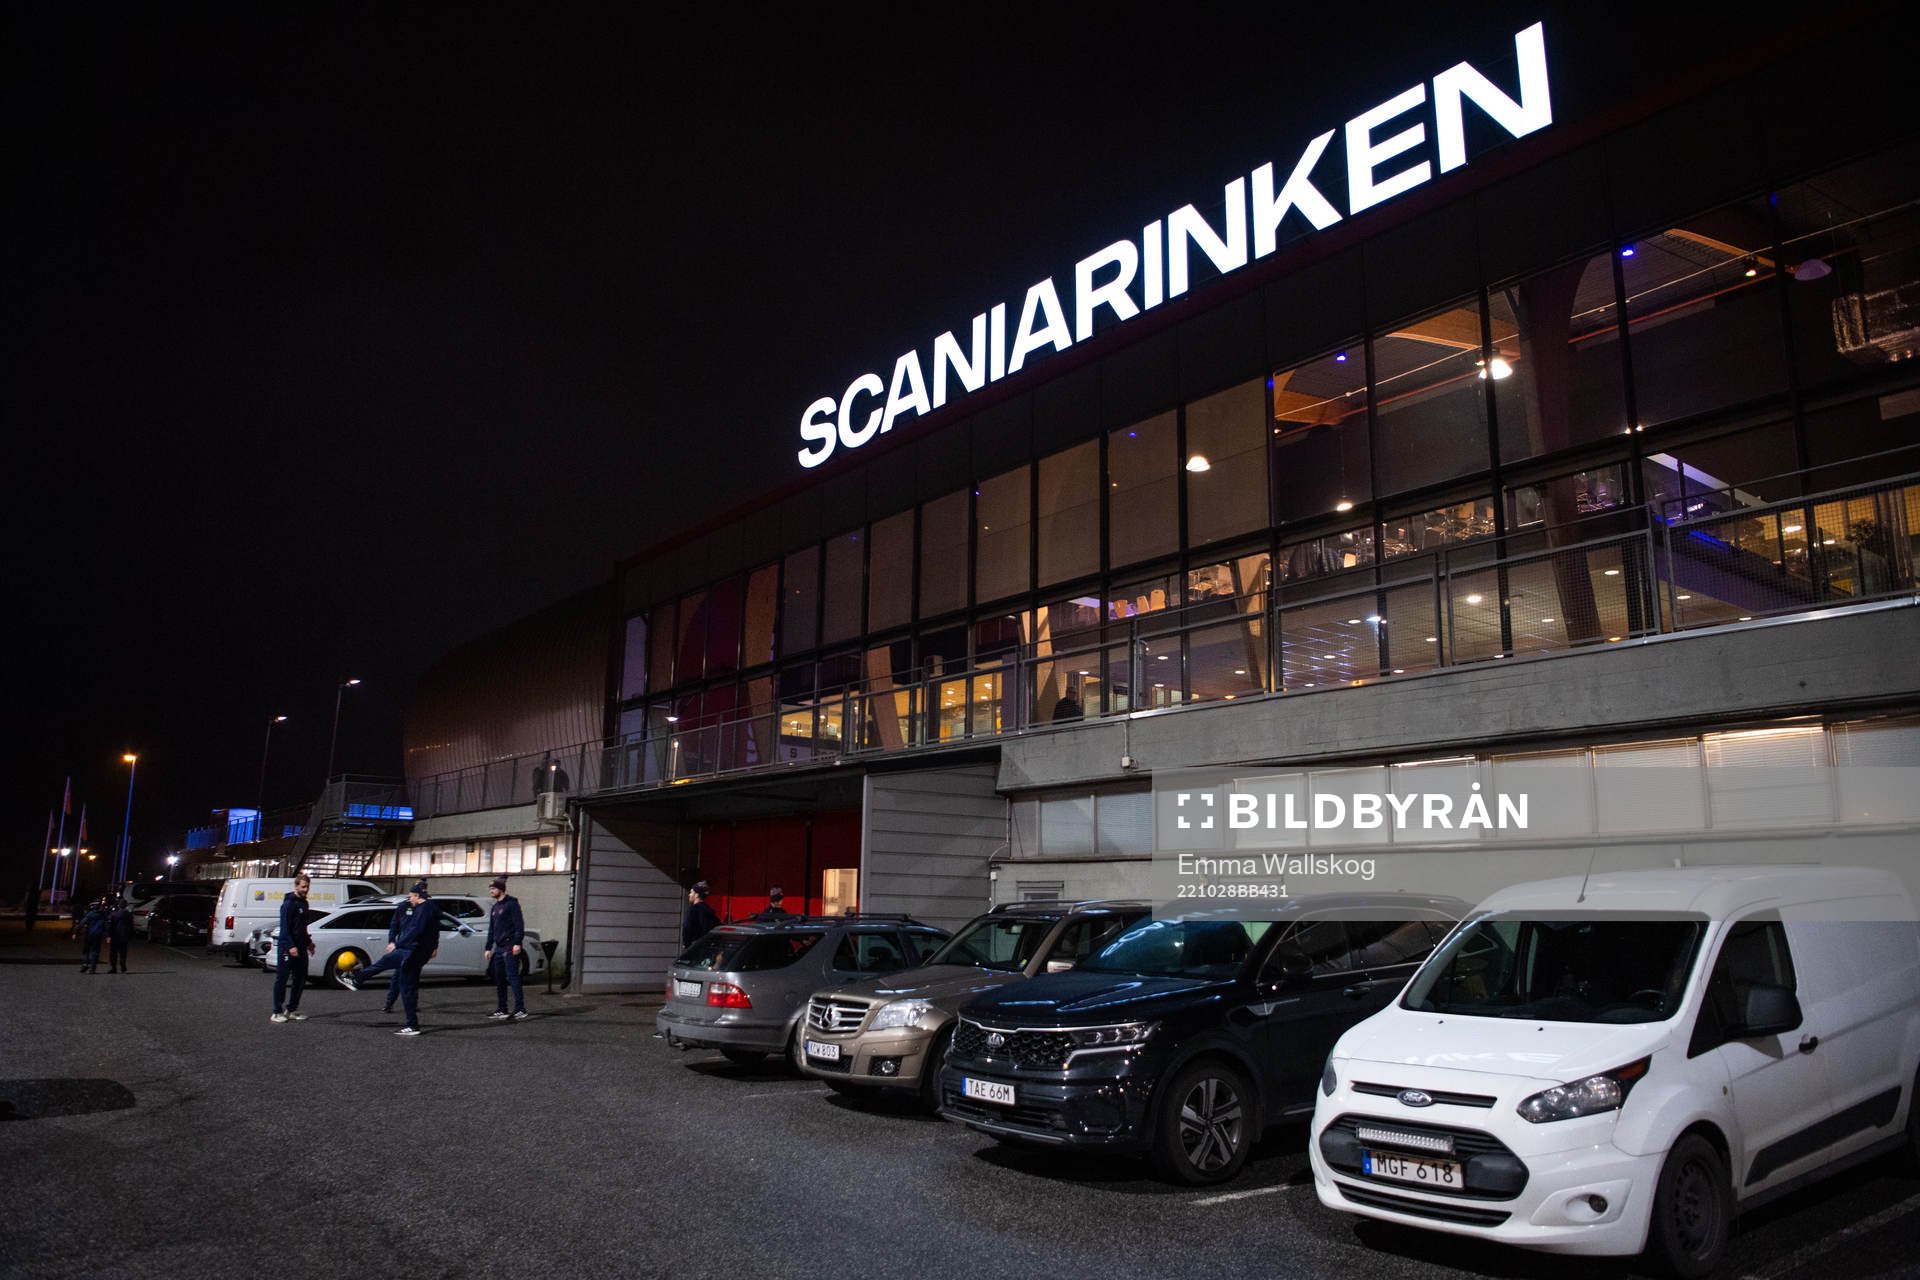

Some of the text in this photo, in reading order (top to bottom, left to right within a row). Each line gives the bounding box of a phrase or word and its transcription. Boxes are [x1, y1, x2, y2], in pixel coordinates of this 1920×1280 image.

[798, 21, 1553, 469] SCANIARINKEN
[969, 1080, 1010, 1102] TAE 66M
[1376, 1153, 1453, 1183] MGF 618
